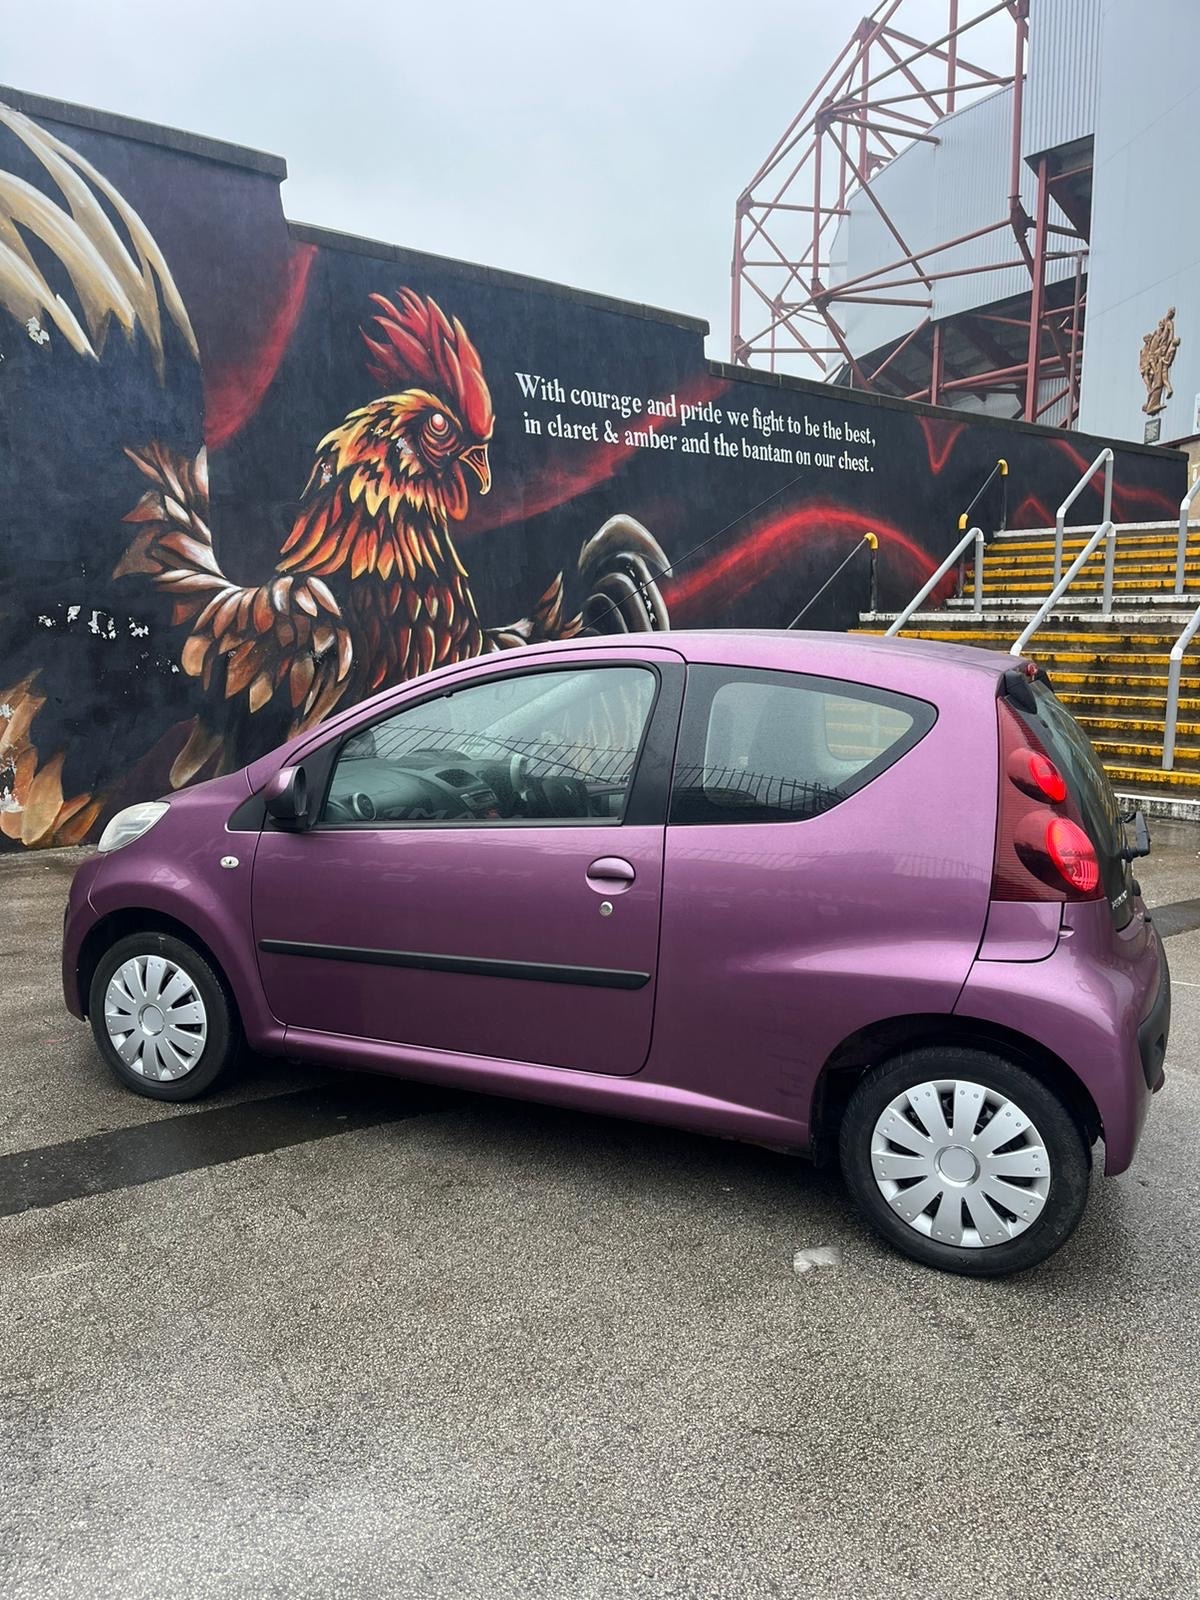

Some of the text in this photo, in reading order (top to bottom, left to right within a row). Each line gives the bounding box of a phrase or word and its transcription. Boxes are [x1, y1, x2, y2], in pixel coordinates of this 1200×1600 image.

[514, 372, 876, 448] With courage and pride we fight to be the best,
[523, 411, 875, 473] in claret & amber and the bantam on our chest.
